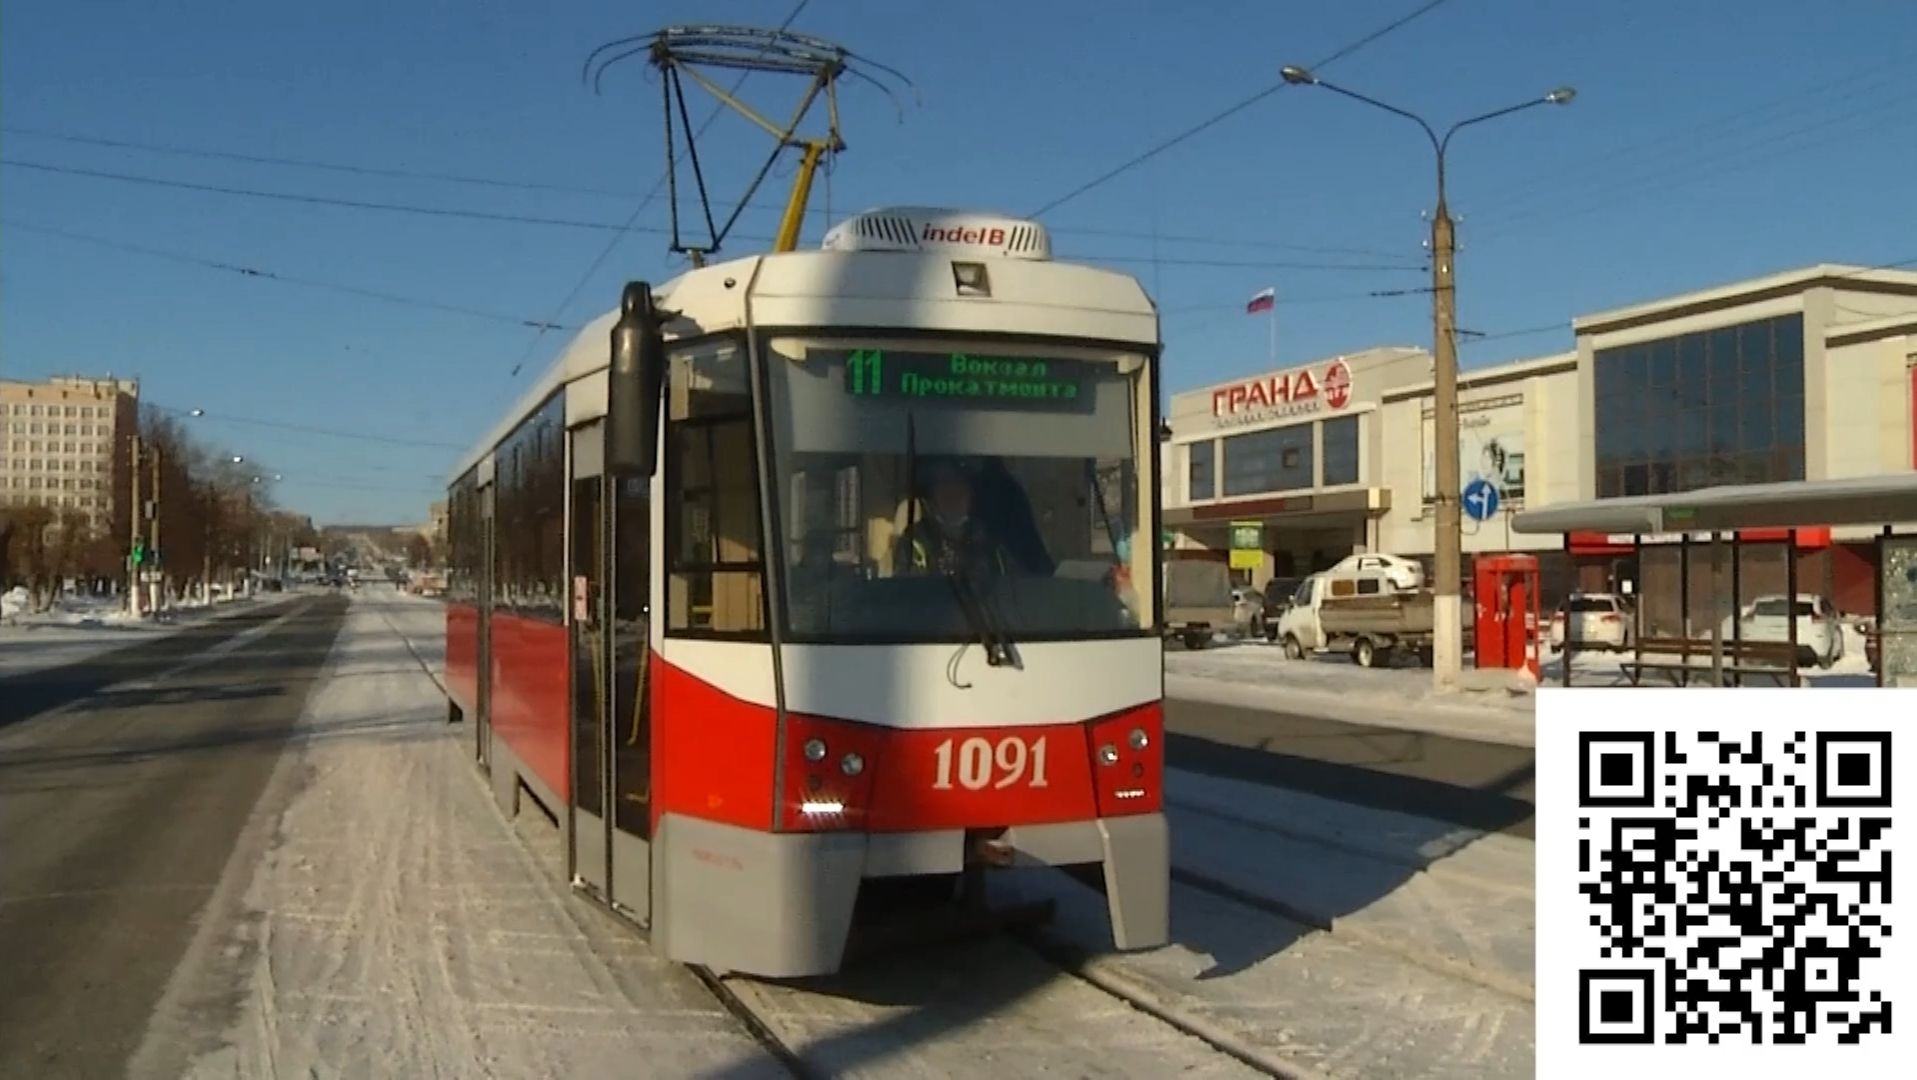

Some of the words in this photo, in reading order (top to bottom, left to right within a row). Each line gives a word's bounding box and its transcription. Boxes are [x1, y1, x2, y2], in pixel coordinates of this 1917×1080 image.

[848, 350, 882, 395] 11
[952, 353, 1047, 376] Вокзал
[1212, 370, 1318, 416] ГРАНД
[932, 735, 1048, 790] 1091
